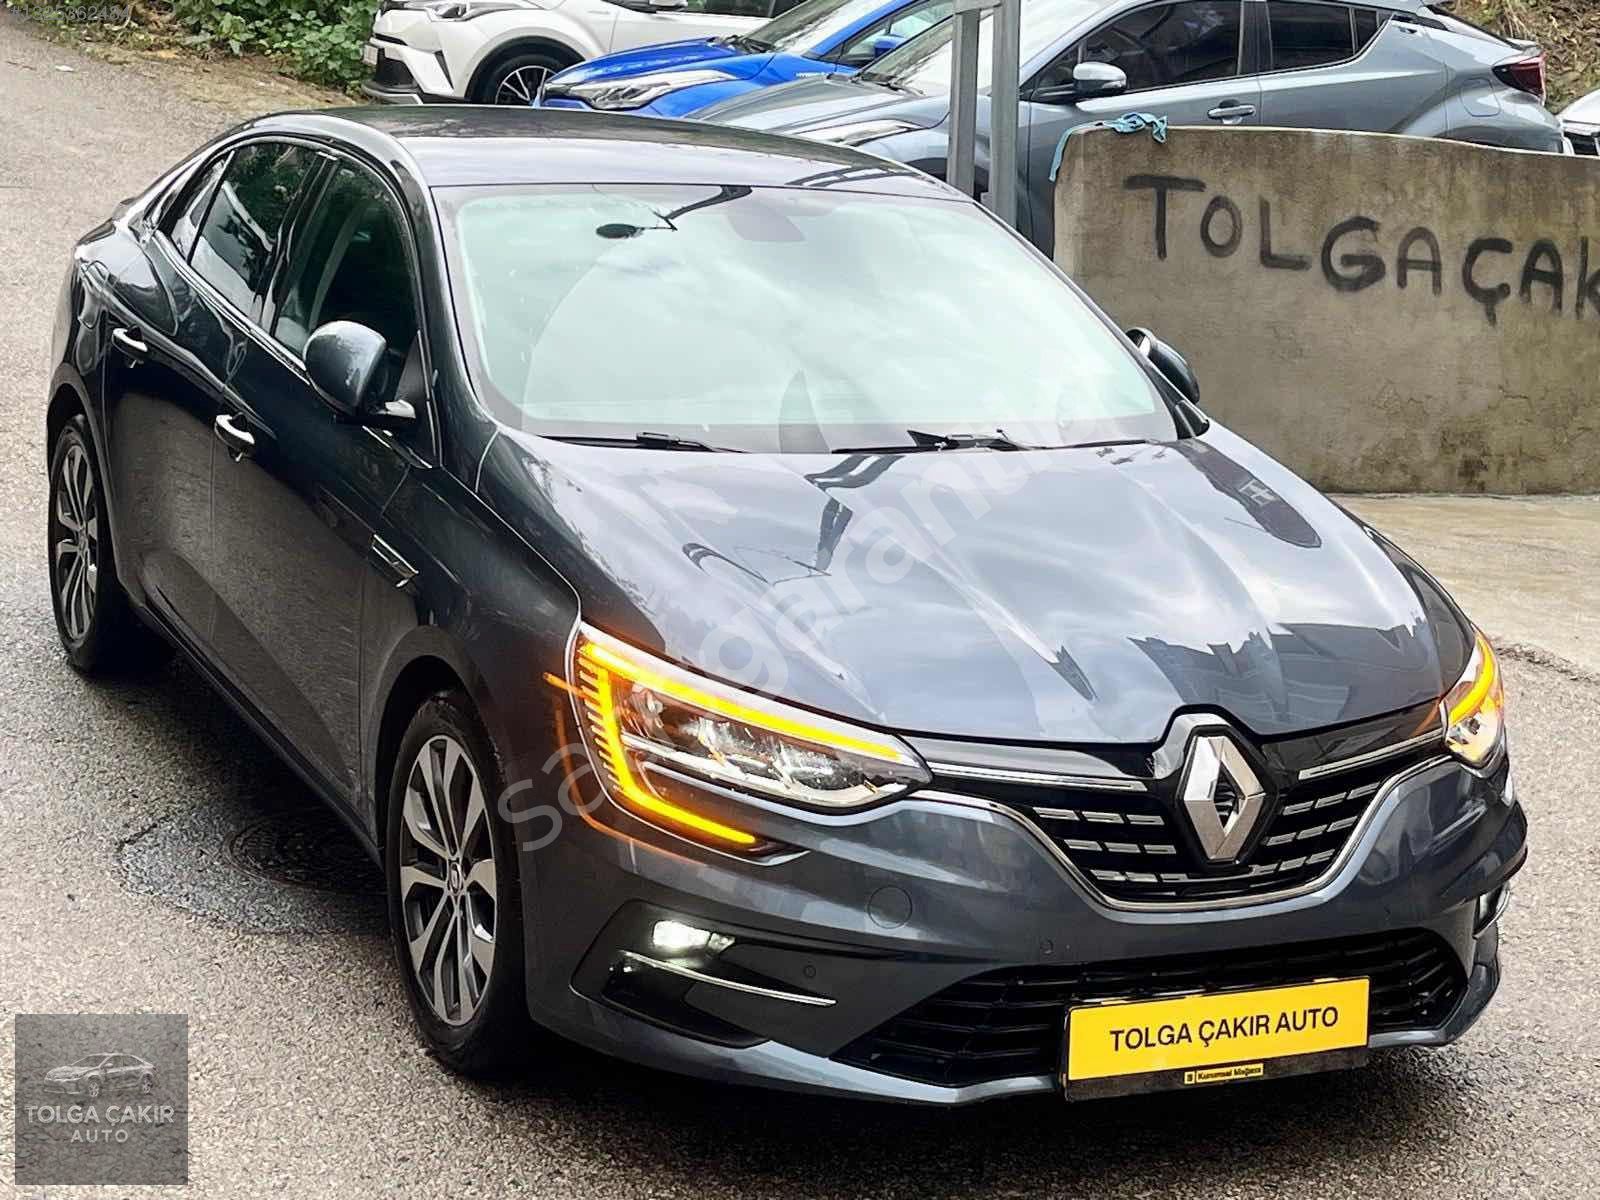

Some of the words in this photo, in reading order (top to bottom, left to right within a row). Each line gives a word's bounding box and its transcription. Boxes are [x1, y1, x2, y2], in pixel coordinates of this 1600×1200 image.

[1110, 1022, 1192, 1051] TOLGA
[1199, 1014, 1270, 1047] ÇAKIR
[1275, 1006, 1338, 1033] AUTO
